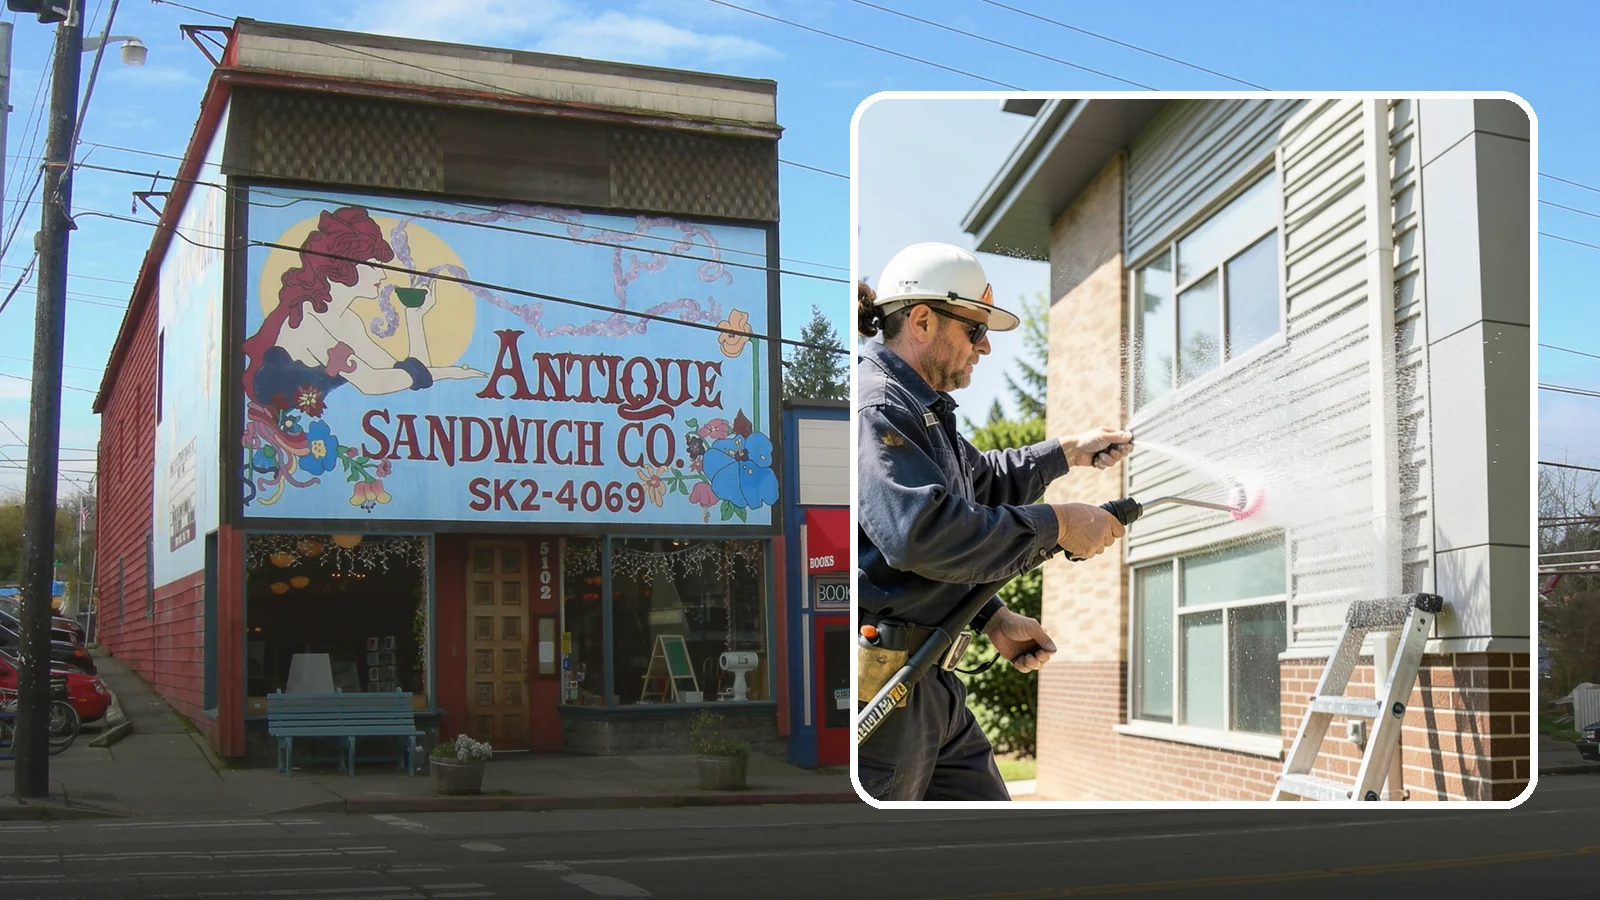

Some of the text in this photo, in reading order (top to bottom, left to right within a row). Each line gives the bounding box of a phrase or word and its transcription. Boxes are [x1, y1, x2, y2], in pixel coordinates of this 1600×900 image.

[475, 328, 724, 421] ANTIQUE
[361, 408, 685, 469] SANDWICH CO.
[469, 477, 645, 513] SK2-4069
[539, 541, 552, 600] 5102
[809, 555, 834, 568] BOOKS
